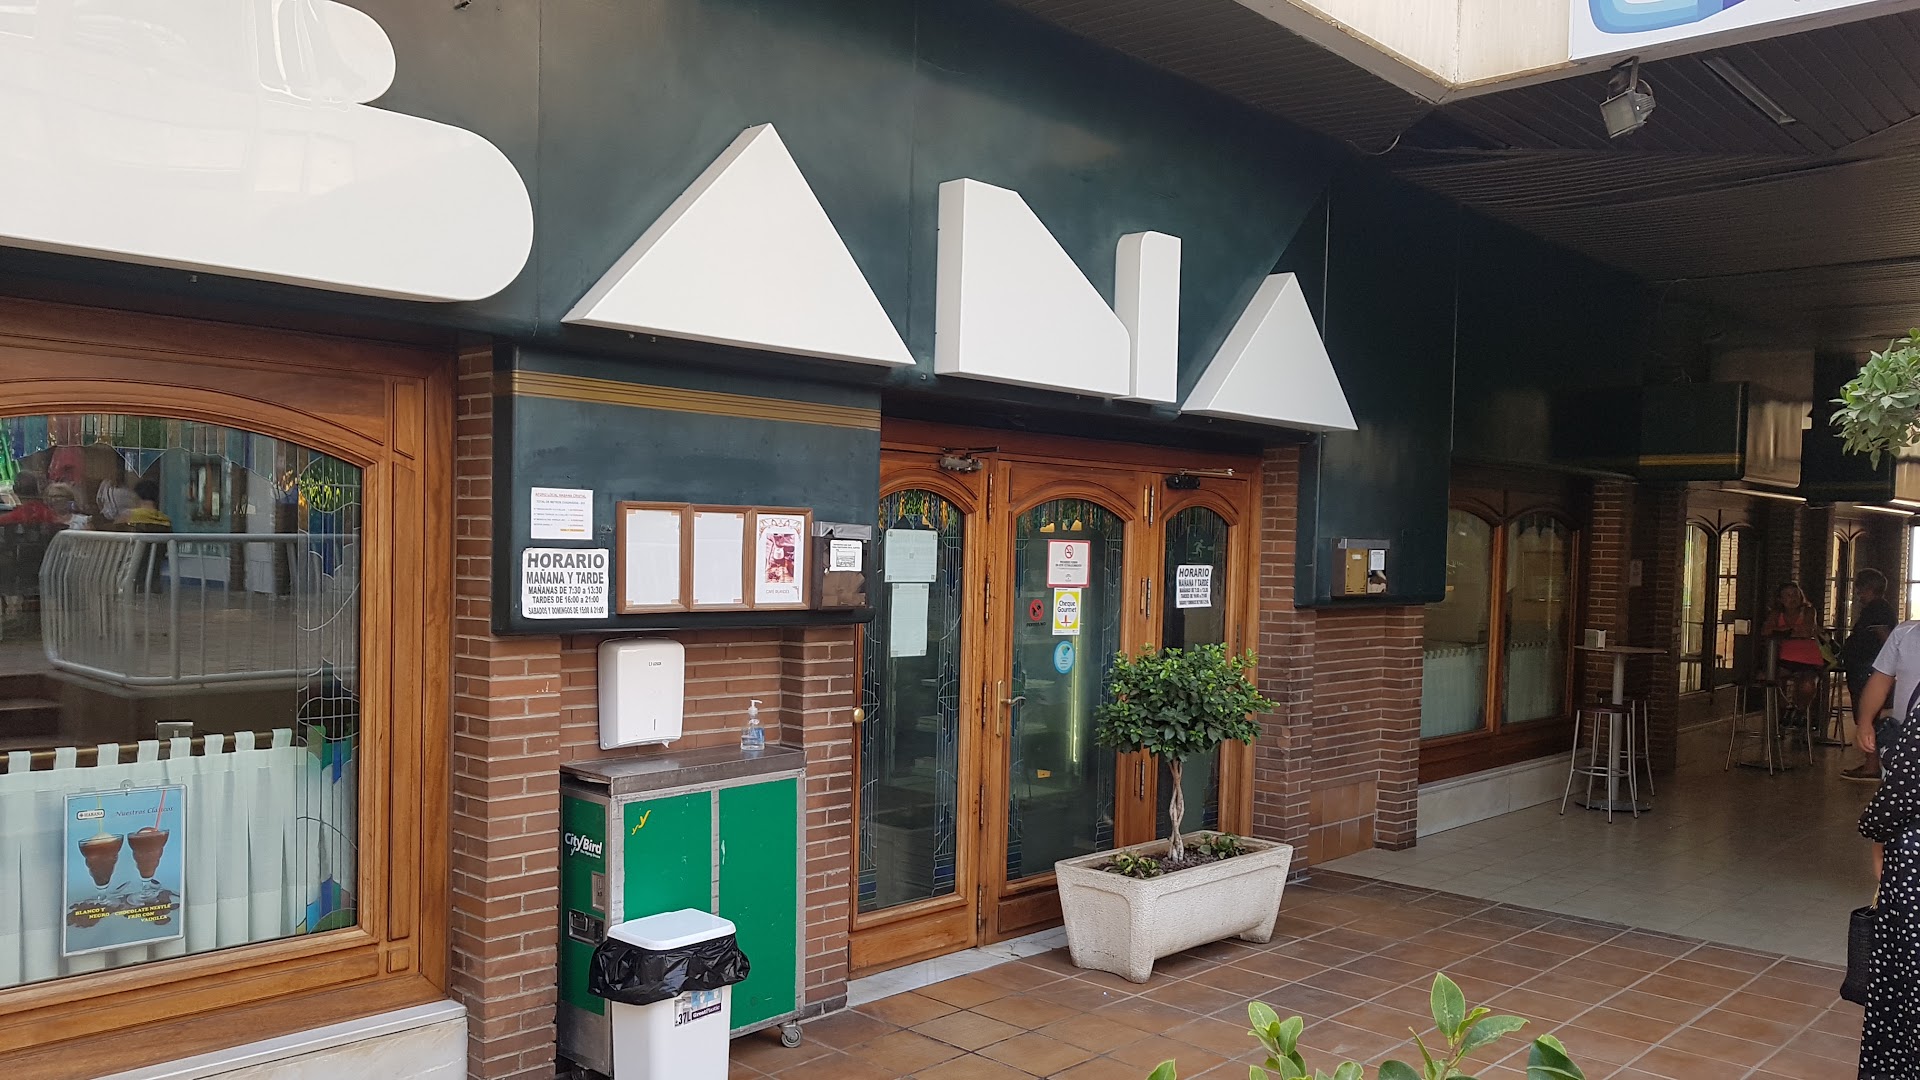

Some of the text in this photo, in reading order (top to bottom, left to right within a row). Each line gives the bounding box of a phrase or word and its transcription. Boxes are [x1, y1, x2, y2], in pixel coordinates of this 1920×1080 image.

[527, 553, 605, 568] HORARIO
[526, 569, 604, 584] MAÑANA Y TARDE
[1179, 568, 1210, 577] HORARIO
[528, 585, 558, 595] MAÑANAS
[559, 586, 567, 594] DE
[569, 586, 580, 594] 7:30
[587, 586, 602, 594] 13:30
[565, 832, 602, 854] CityBird
[75, 907, 100, 916] BLANCO
[114, 906, 149, 916] CHOCOLATE
